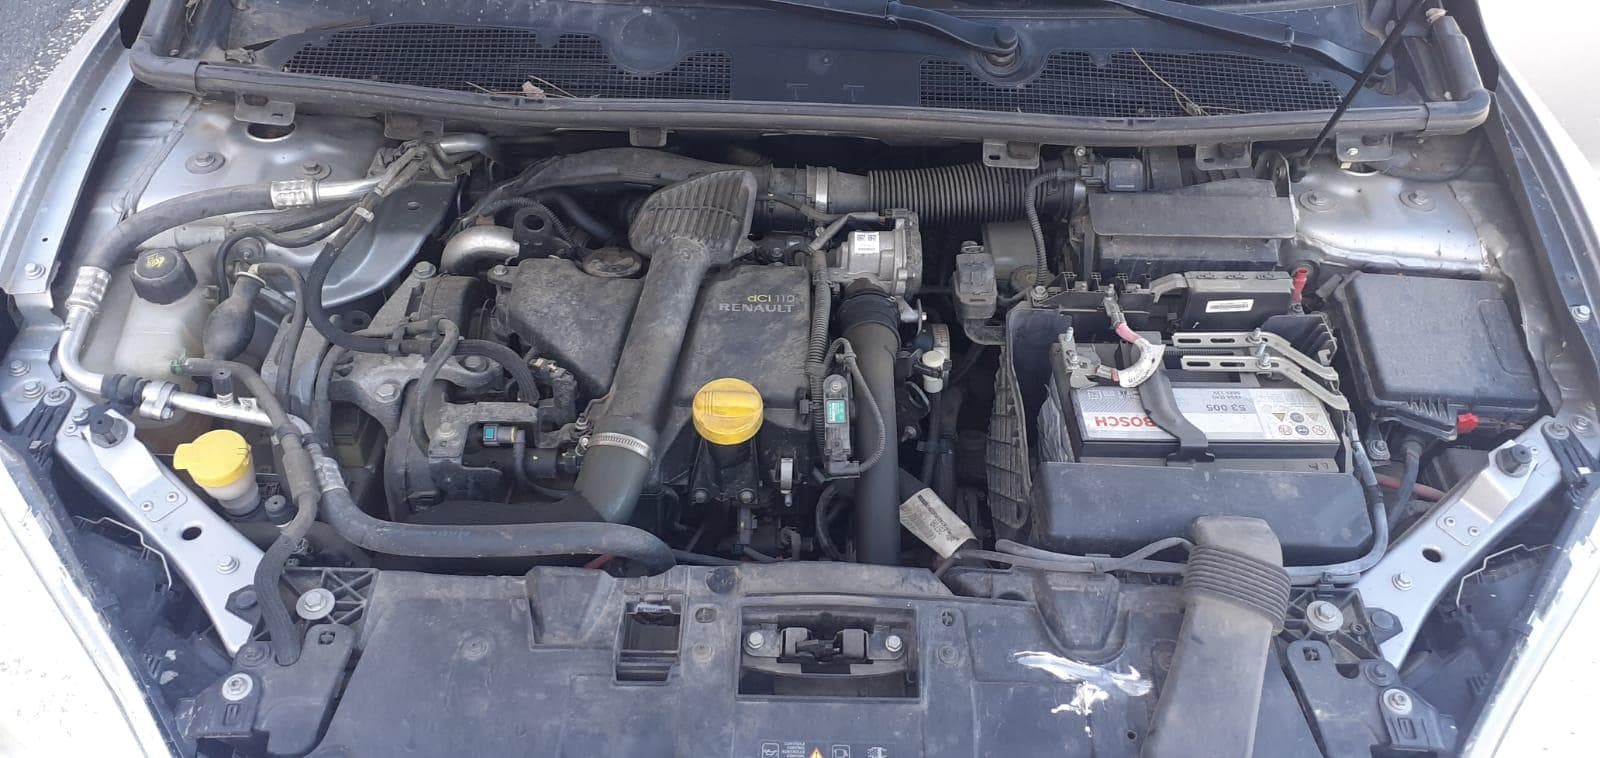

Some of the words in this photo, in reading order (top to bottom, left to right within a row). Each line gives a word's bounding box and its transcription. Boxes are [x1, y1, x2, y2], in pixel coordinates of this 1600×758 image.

[774, 294, 796, 303] 110
[719, 303, 796, 313] RENAULT
[1094, 415, 1158, 428] BOSCH
